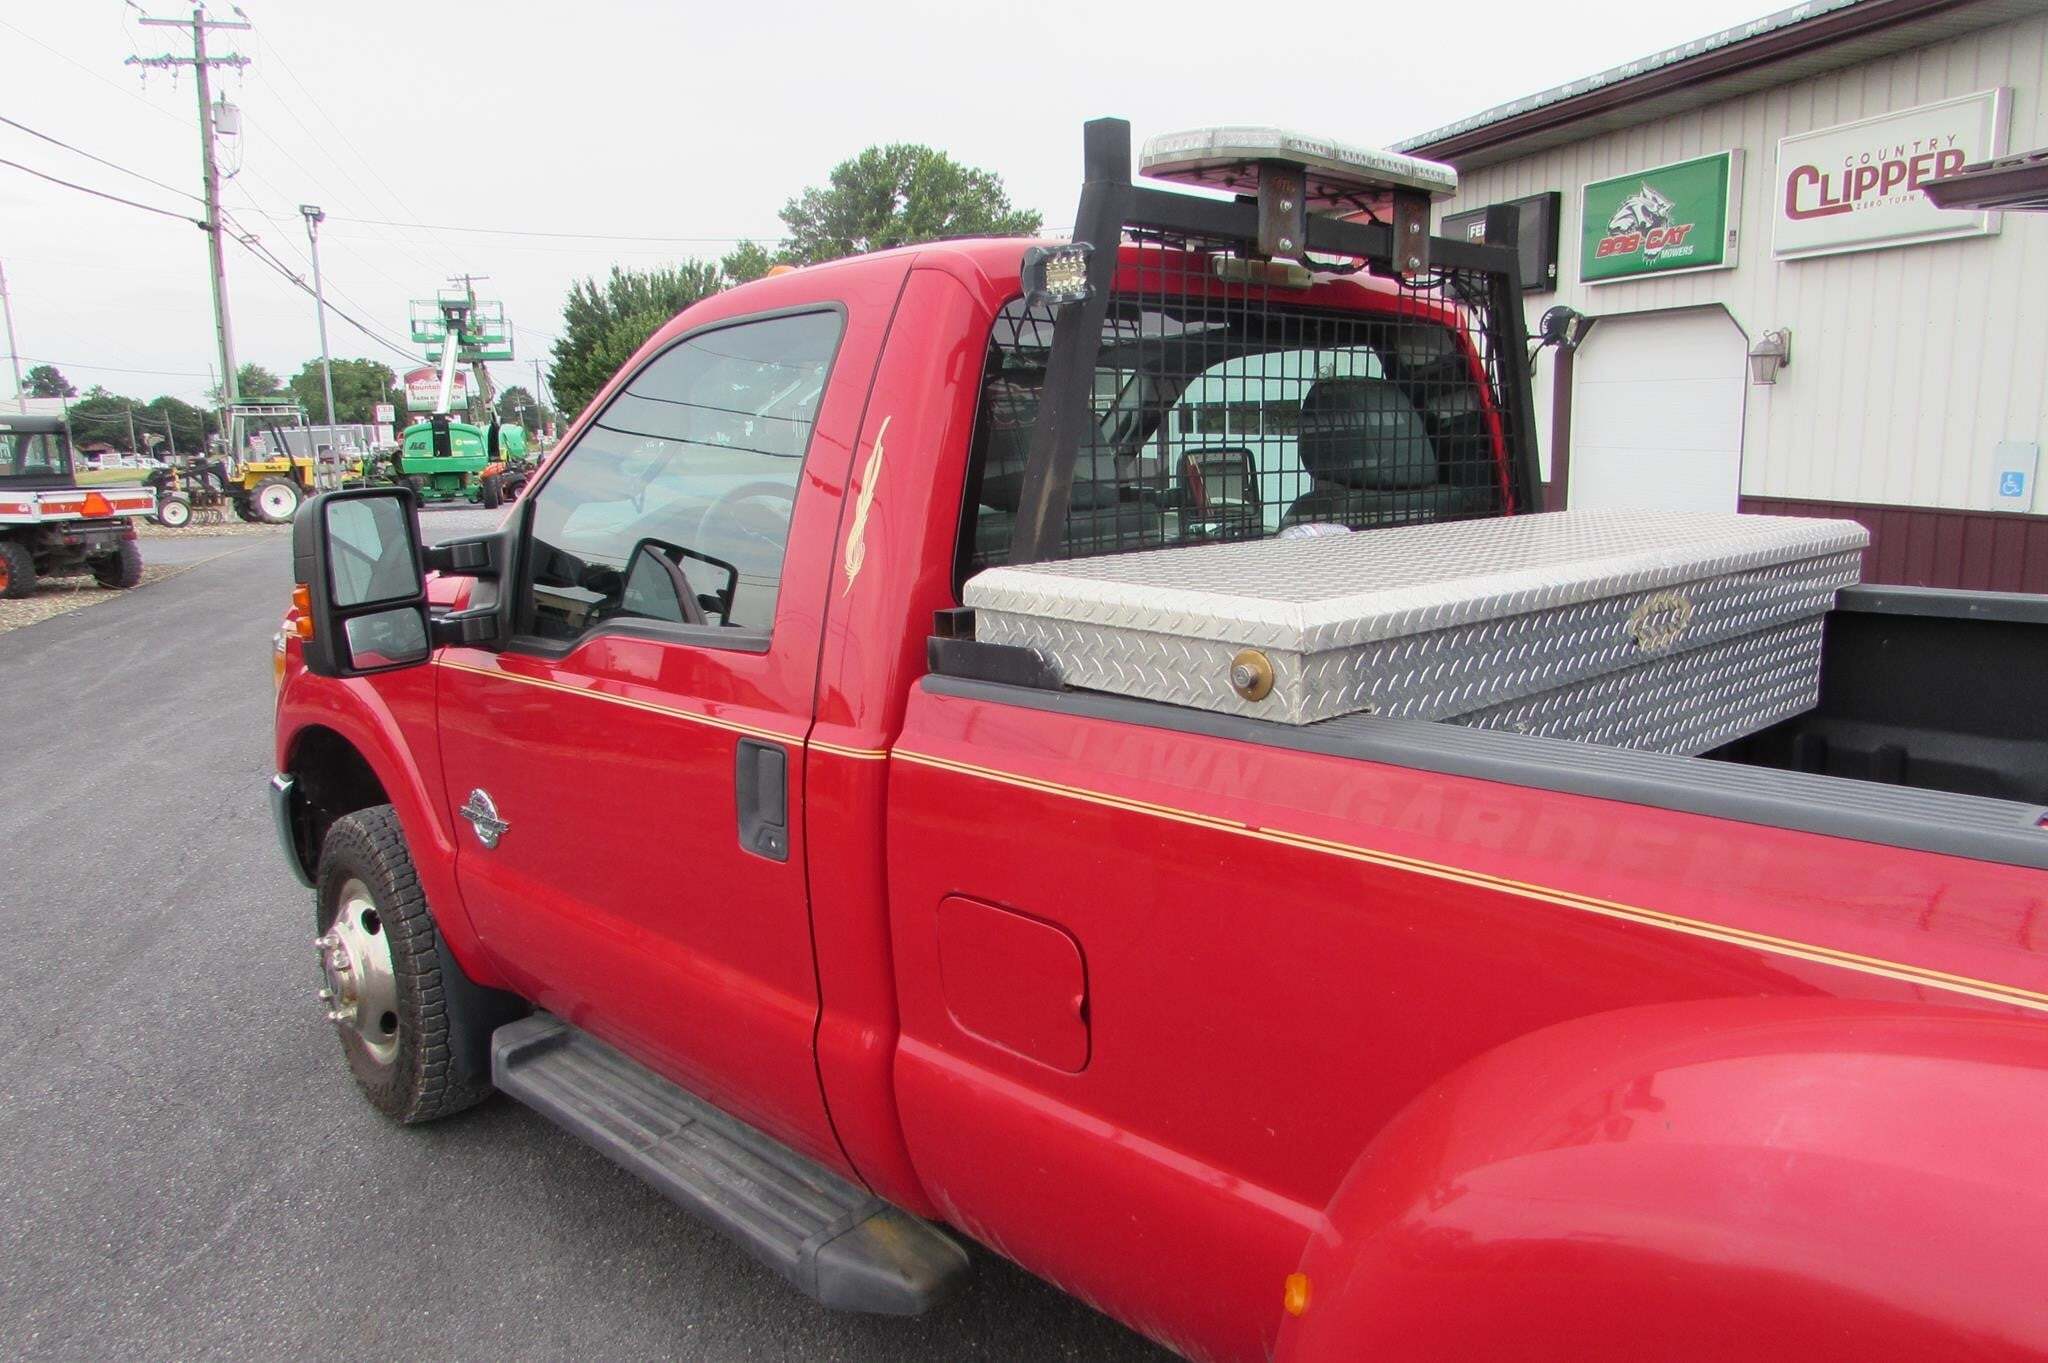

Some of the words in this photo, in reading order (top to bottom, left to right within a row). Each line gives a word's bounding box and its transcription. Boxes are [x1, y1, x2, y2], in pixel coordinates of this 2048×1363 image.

[1845, 134, 1956, 167] COUNTRY
[1785, 149, 1966, 221] CLIPPER
[1856, 199, 1882, 210] ZERO
[1889, 194, 1915, 204] TURN
[1661, 245, 1694, 259] MOWERS
[409, 441, 427, 450] JLG
